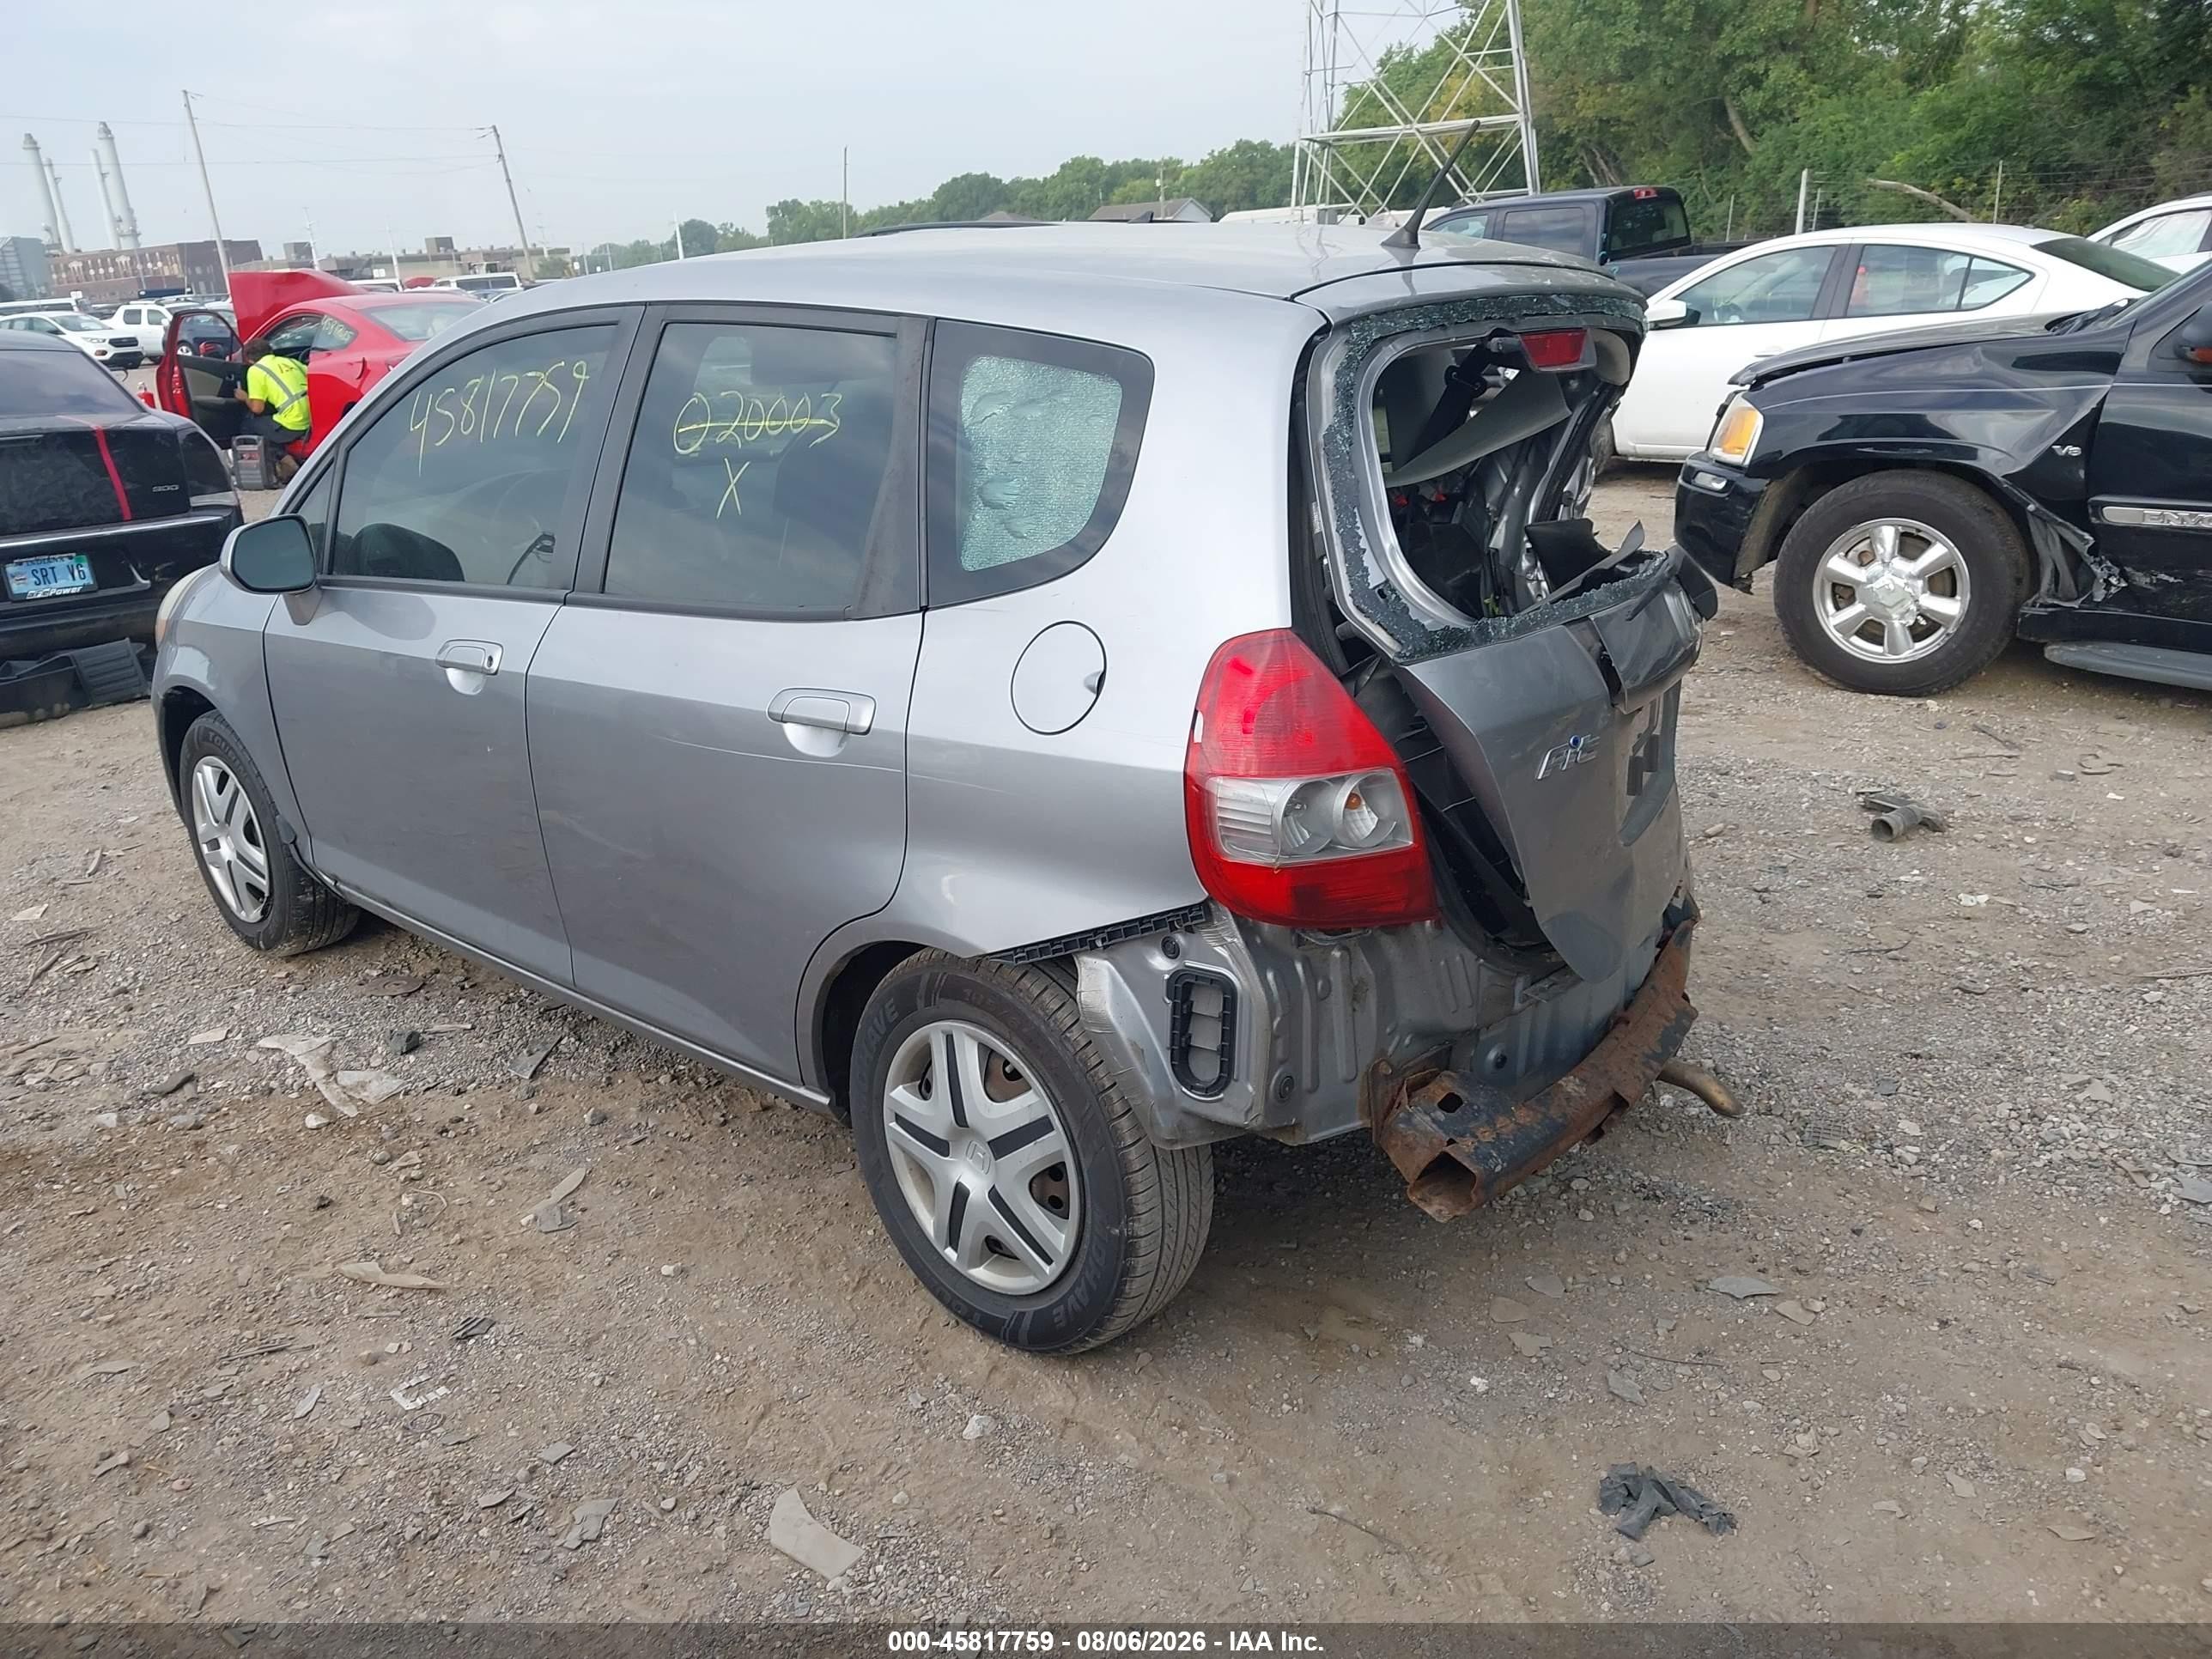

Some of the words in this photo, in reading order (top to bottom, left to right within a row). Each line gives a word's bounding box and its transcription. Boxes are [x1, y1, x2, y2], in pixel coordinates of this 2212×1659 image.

[409, 359, 590, 477] 45817759
[672, 390, 843, 455] 020003
[715, 457, 751, 519] X
[31, 566, 58, 586] SRT
